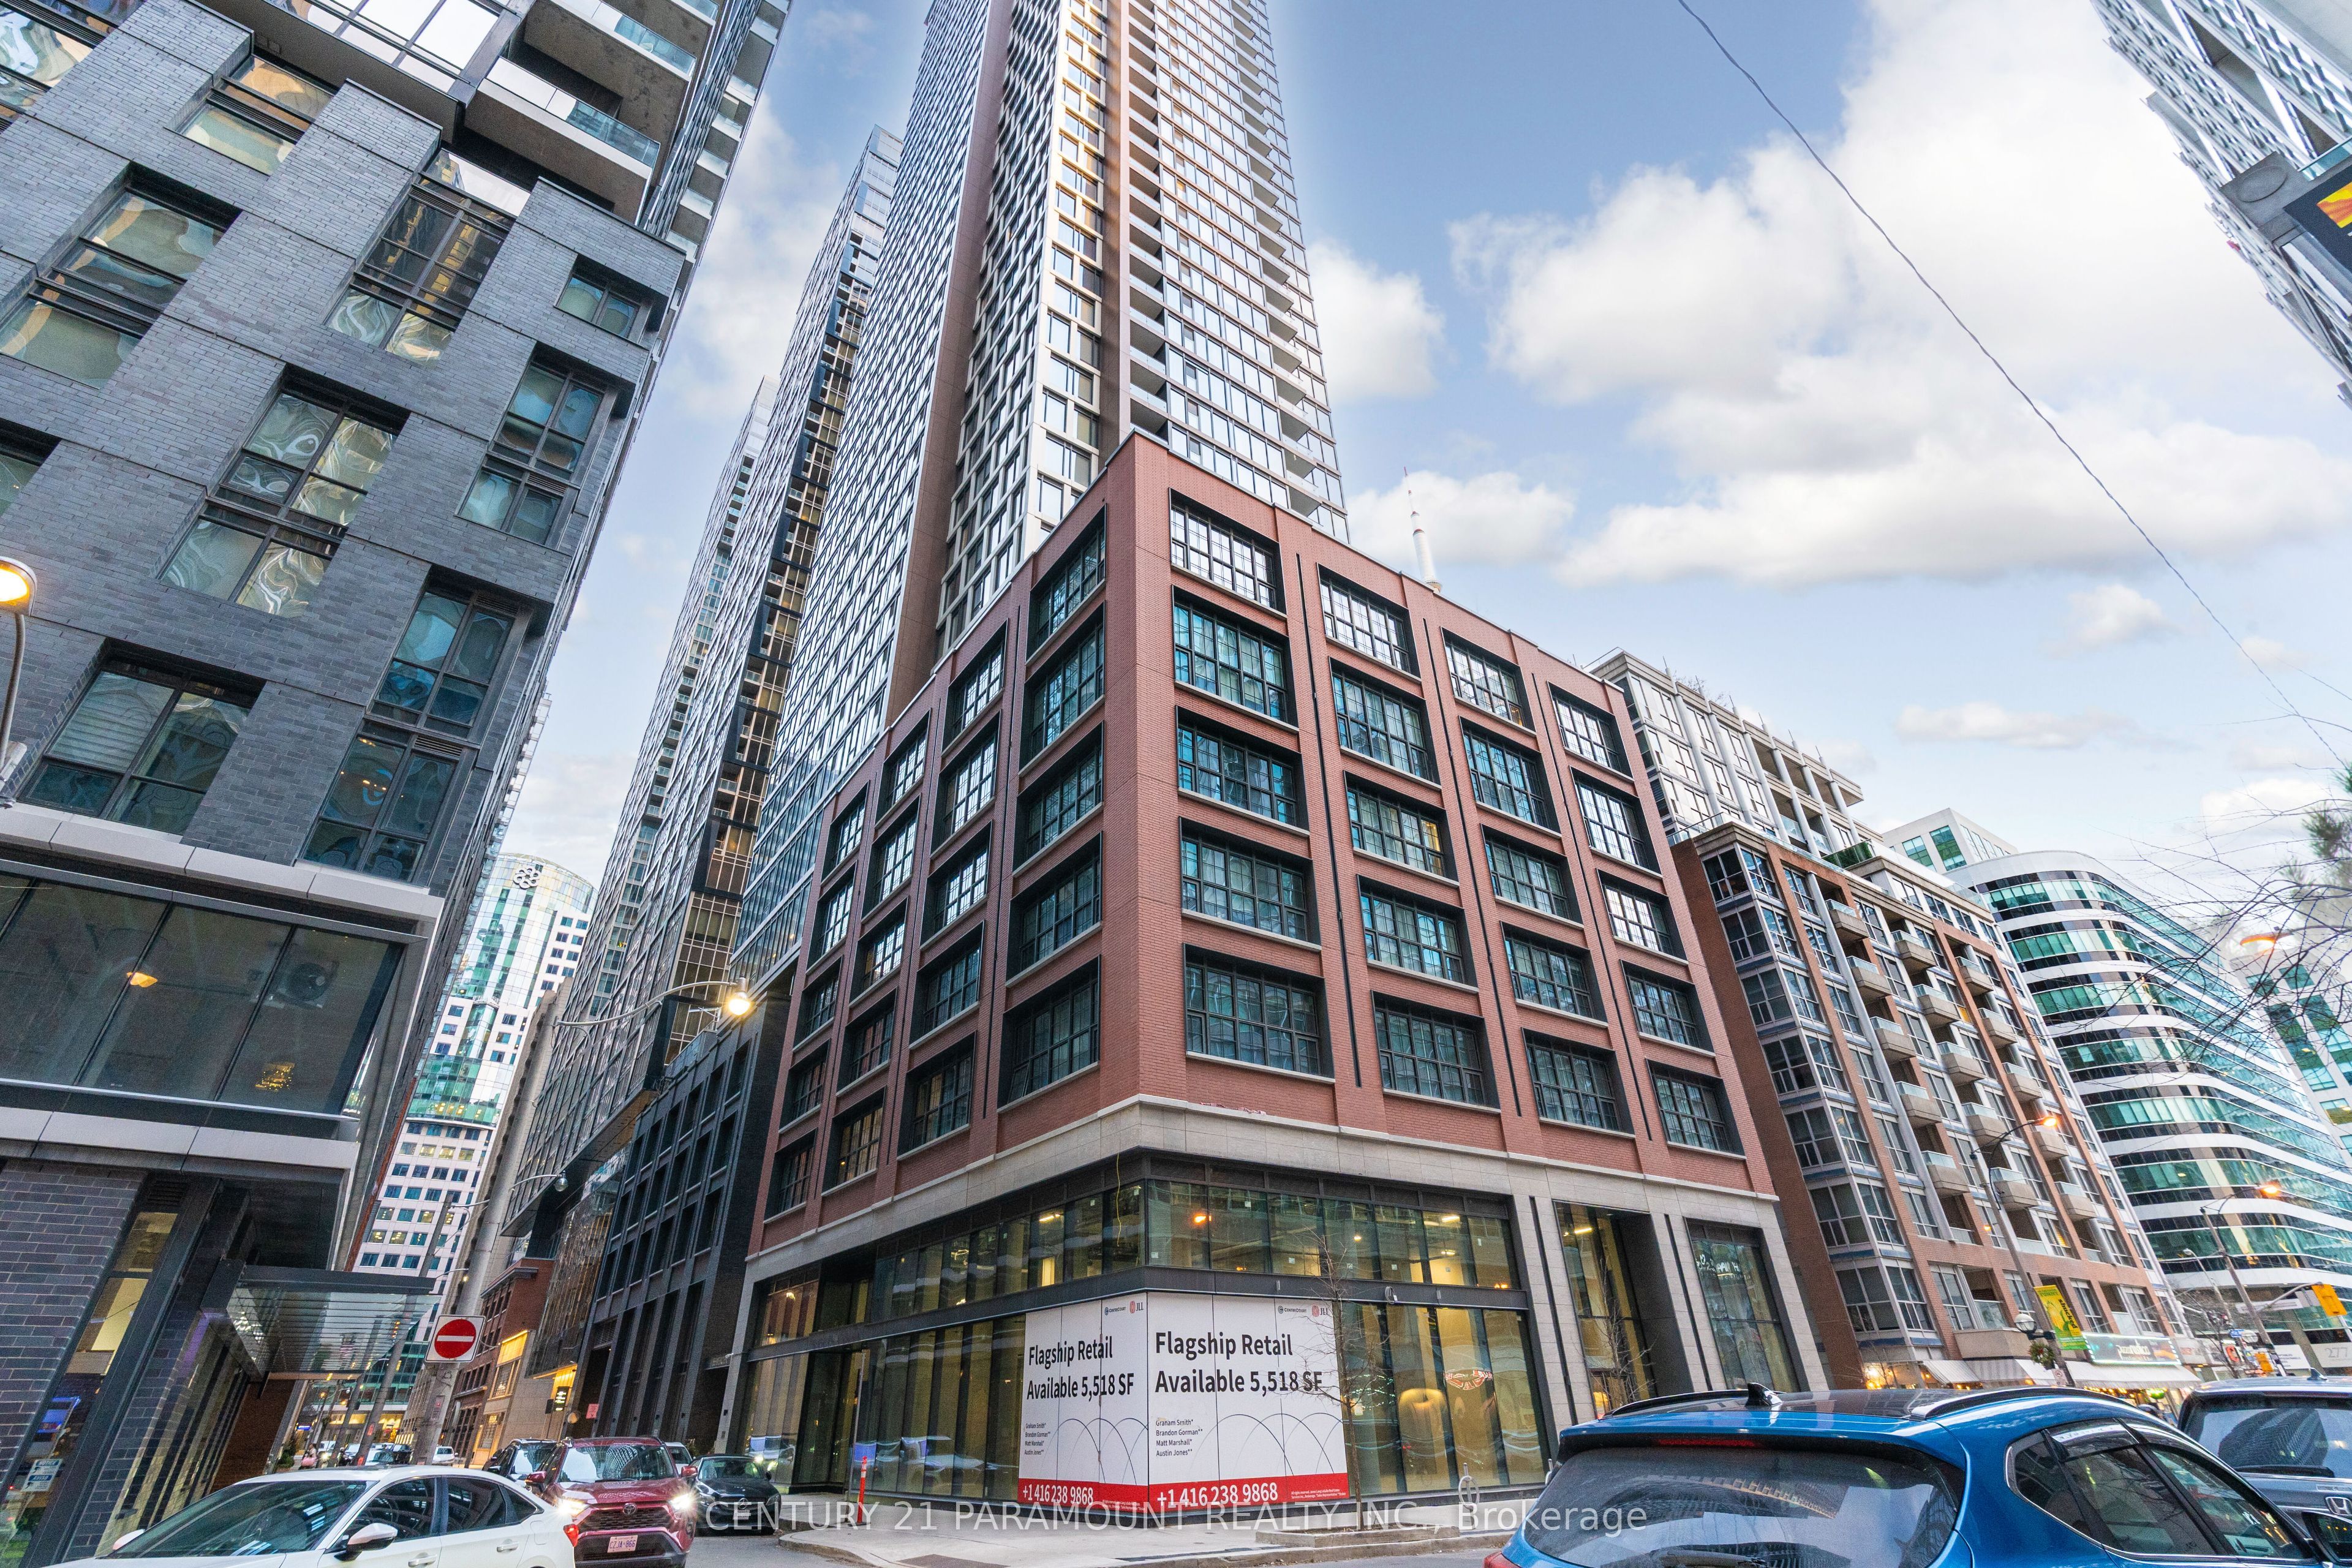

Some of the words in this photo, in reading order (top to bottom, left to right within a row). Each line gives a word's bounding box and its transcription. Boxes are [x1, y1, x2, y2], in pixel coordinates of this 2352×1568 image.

[1029, 1341, 1074, 1370] Flagship
[1078, 1336, 1113, 1360] Retail
[1156, 1331, 1236, 1361] Flagship
[1242, 1333, 1293, 1356] Retail
[2324, 1347, 2348, 1358] 277
[1027, 1376, 1078, 1400] Available
[1081, 1374, 1115, 1402] 5,518
[1118, 1373, 1134, 1396] SF
[1155, 1369, 1245, 1393] Available
[1250, 1371, 1299, 1397] 5,518
[1303, 1371, 1322, 1392] SF
[1023, 1483, 1033, 1501] +1
[1034, 1484, 1050, 1502] 416
[1051, 1485, 1068, 1504] 238
[1070, 1486, 1093, 1506] 9868
[1157, 1489, 1176, 1509] +1
[1179, 1487, 1208, 1507] 416
[1211, 1485, 1238, 1506] 238
[1242, 1482, 1278, 1503] 9868
